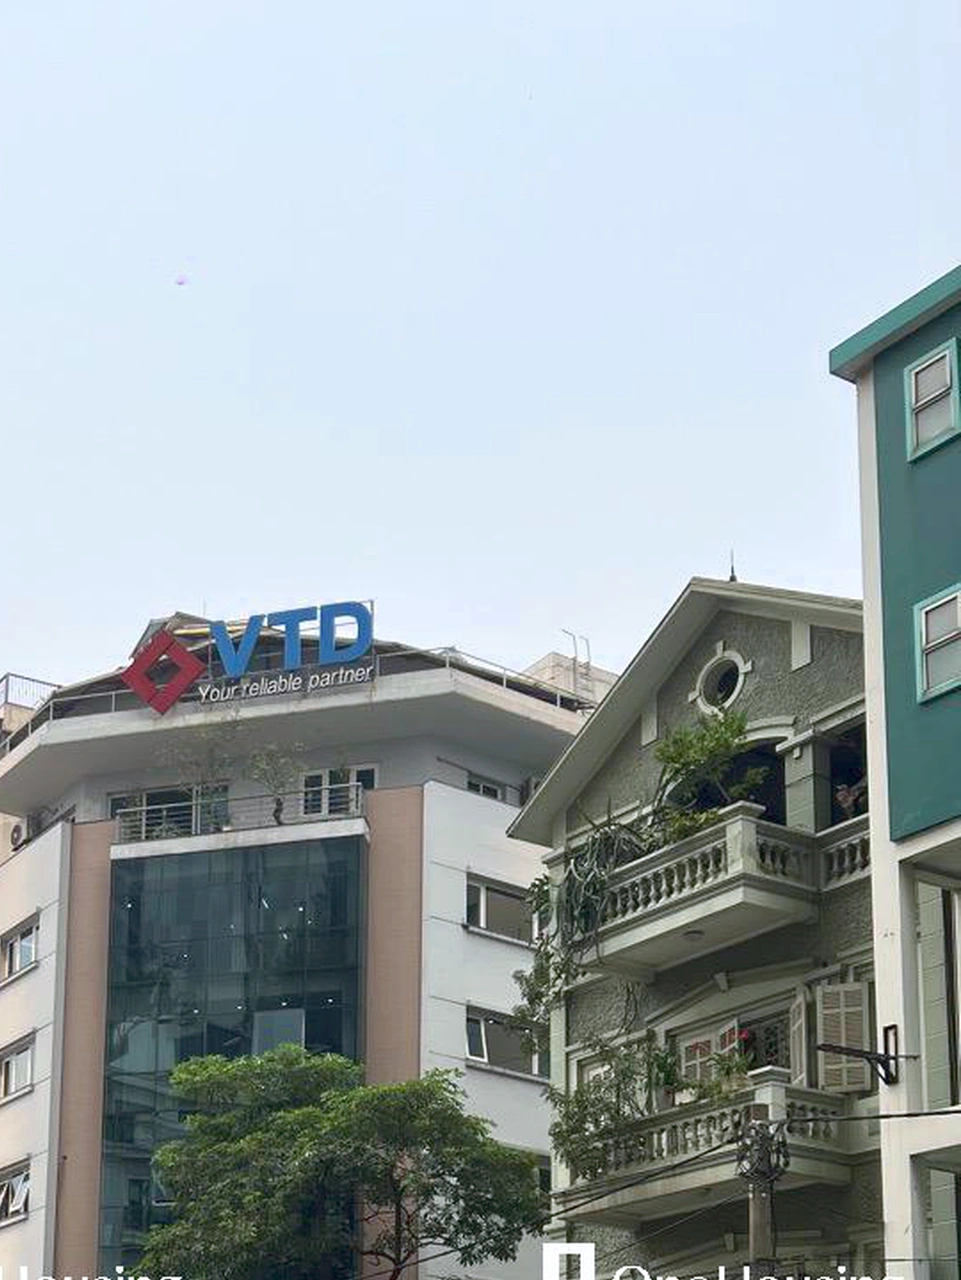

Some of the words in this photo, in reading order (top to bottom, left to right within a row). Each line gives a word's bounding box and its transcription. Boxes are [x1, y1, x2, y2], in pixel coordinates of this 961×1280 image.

[209, 602, 373, 678] VTD
[198, 683, 239, 704] Your
[242, 672, 302, 698] reliable
[307, 665, 373, 691] partner
